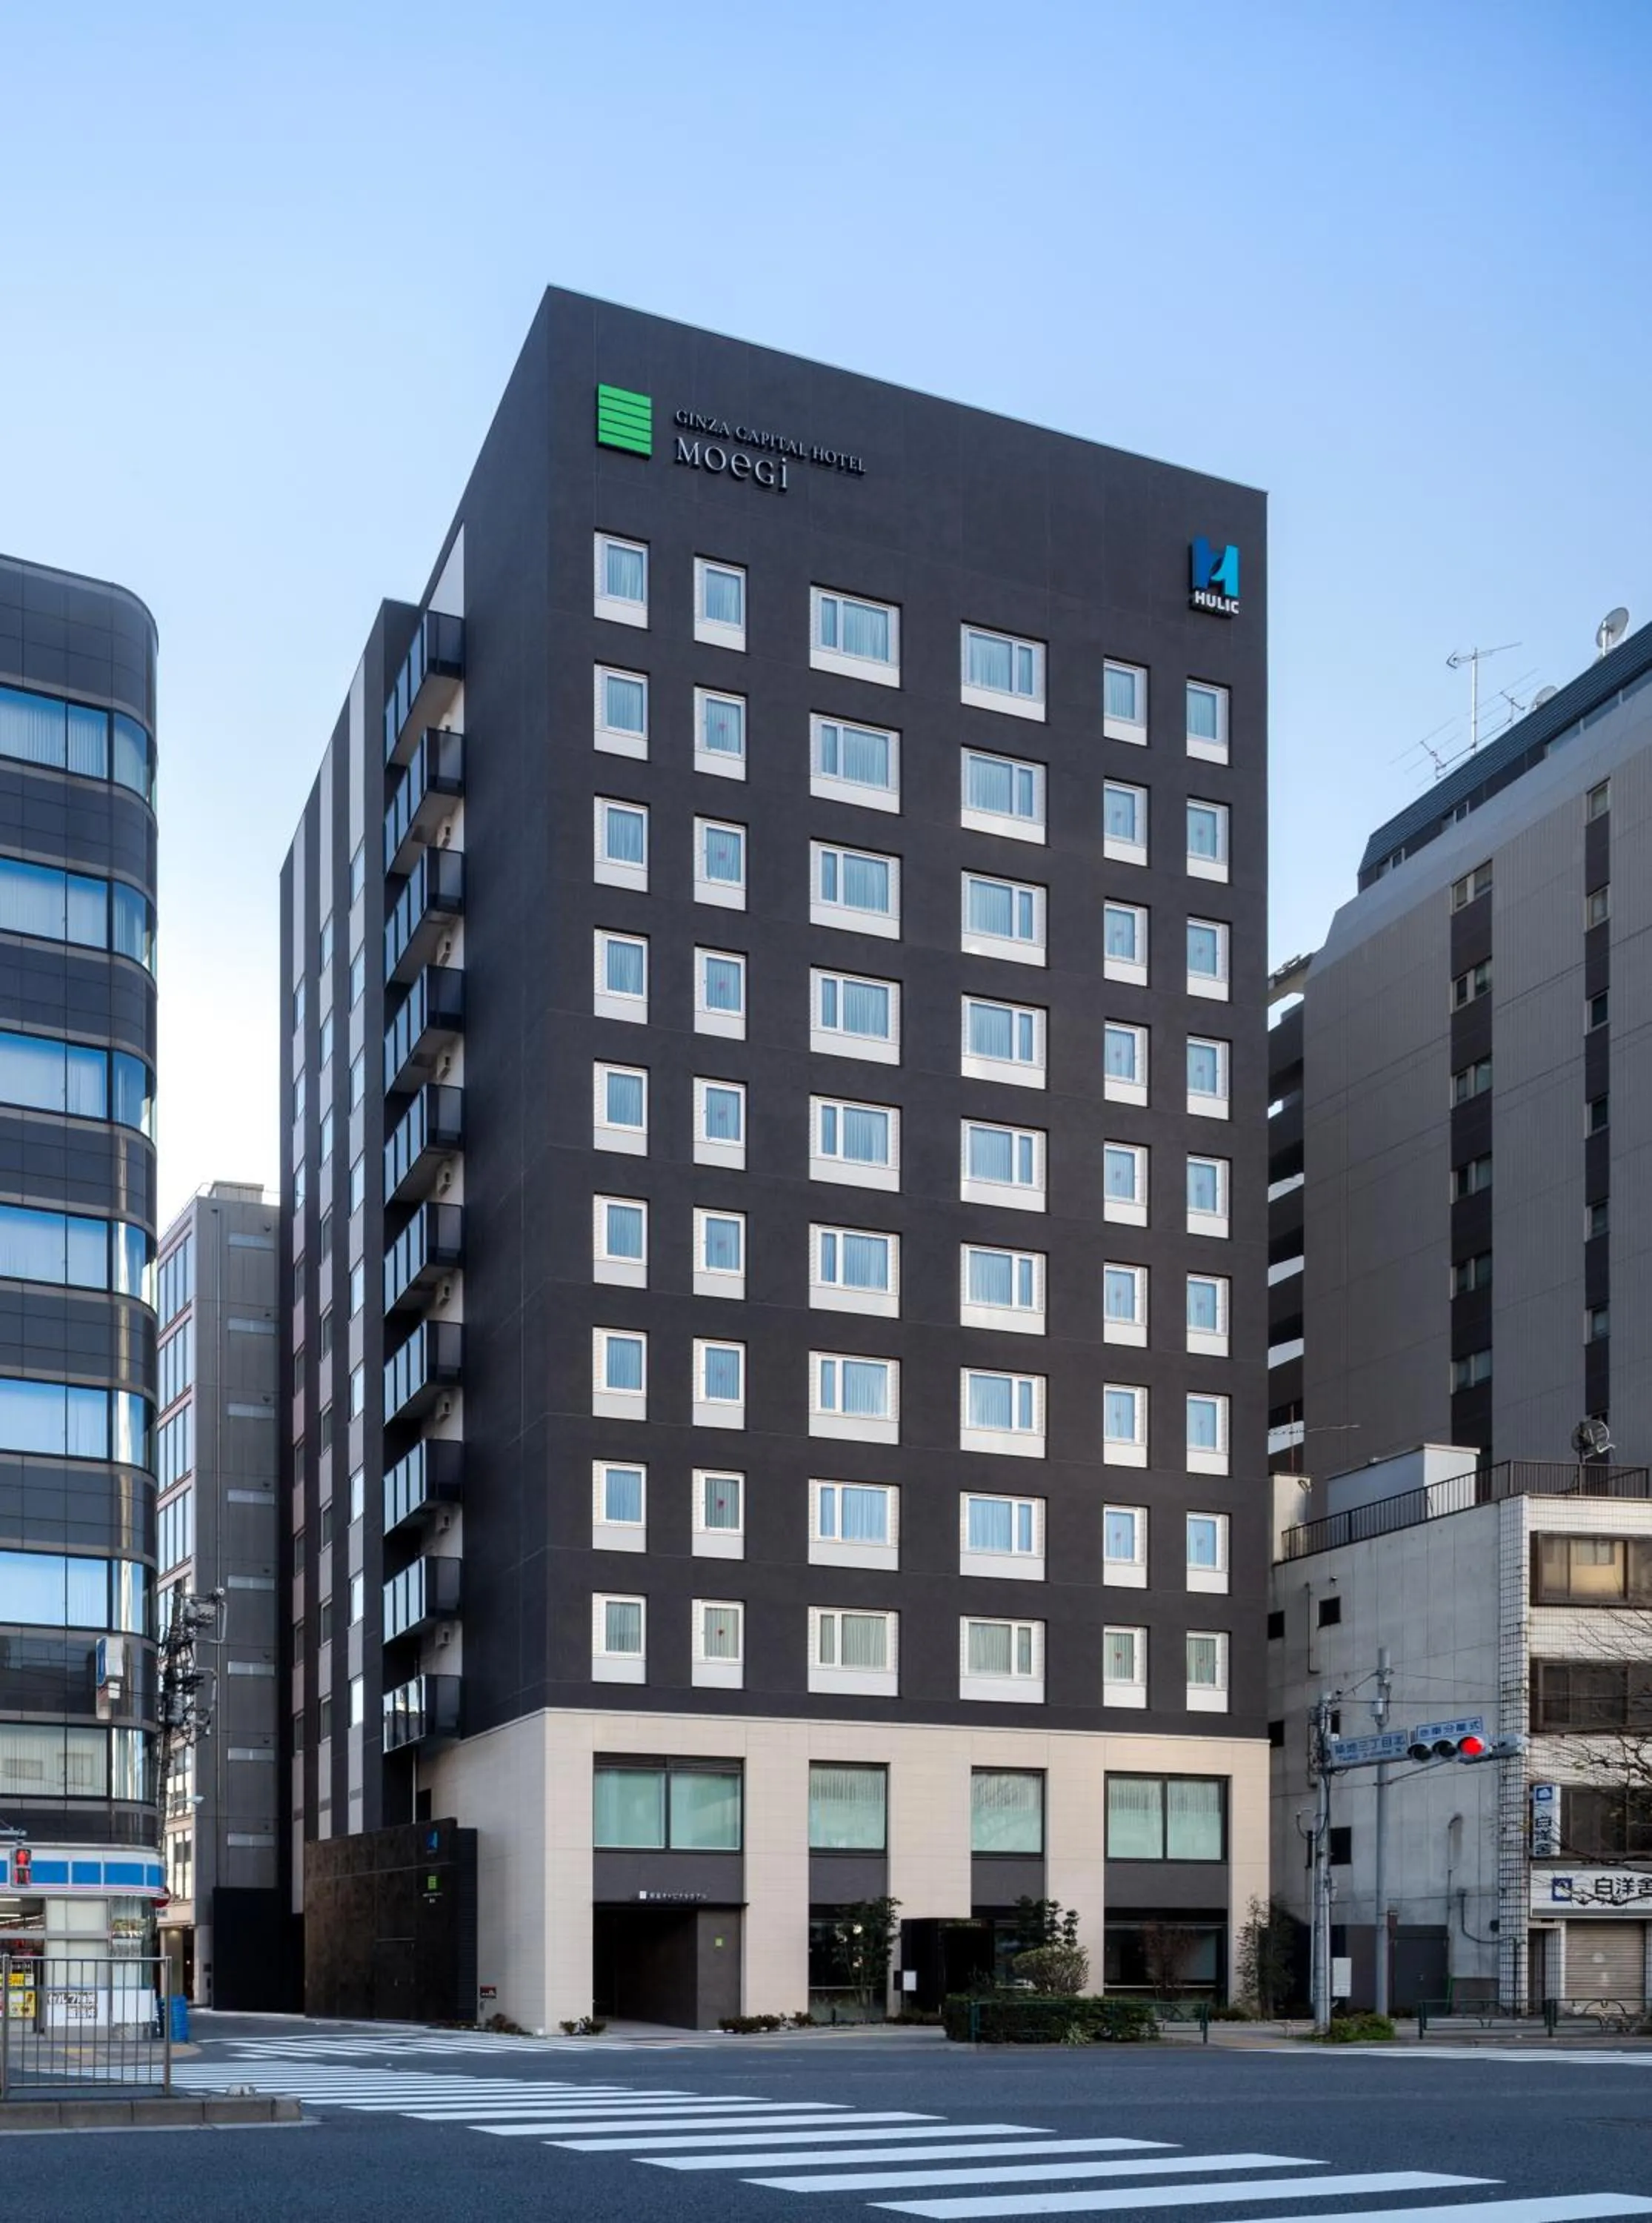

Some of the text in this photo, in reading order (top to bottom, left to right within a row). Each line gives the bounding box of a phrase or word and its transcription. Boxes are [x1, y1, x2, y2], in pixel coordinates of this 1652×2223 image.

[676, 409, 866, 472] GINZA CAPITAL HOTEL
[1194, 591, 1239, 614] HULIC
